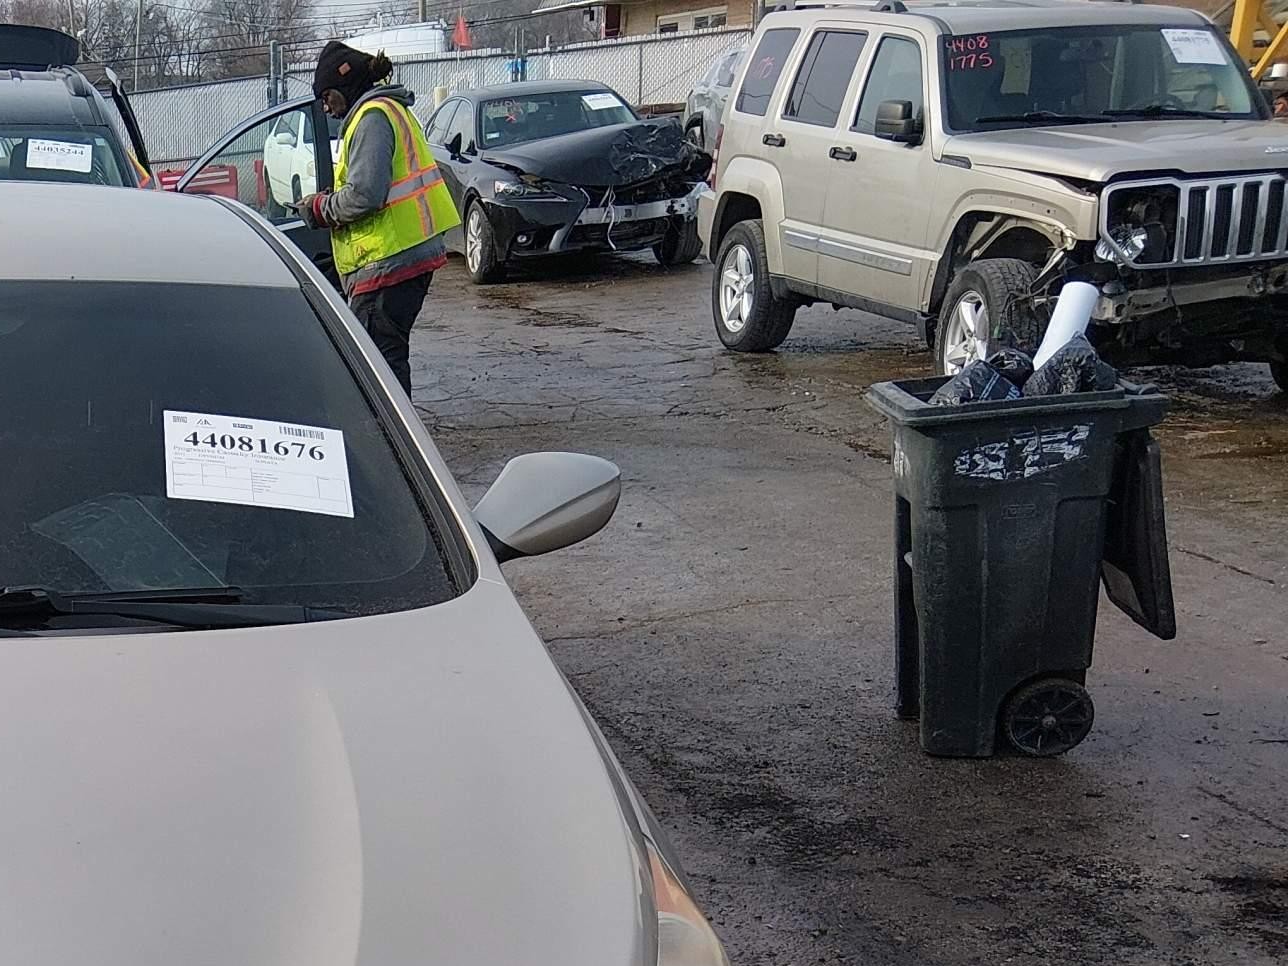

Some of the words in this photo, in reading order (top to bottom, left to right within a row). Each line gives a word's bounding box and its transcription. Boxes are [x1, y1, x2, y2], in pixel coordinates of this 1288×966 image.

[945, 36, 989, 52] 4408
[950, 53, 993, 70] 1775
[184, 431, 325, 461] 44081676
